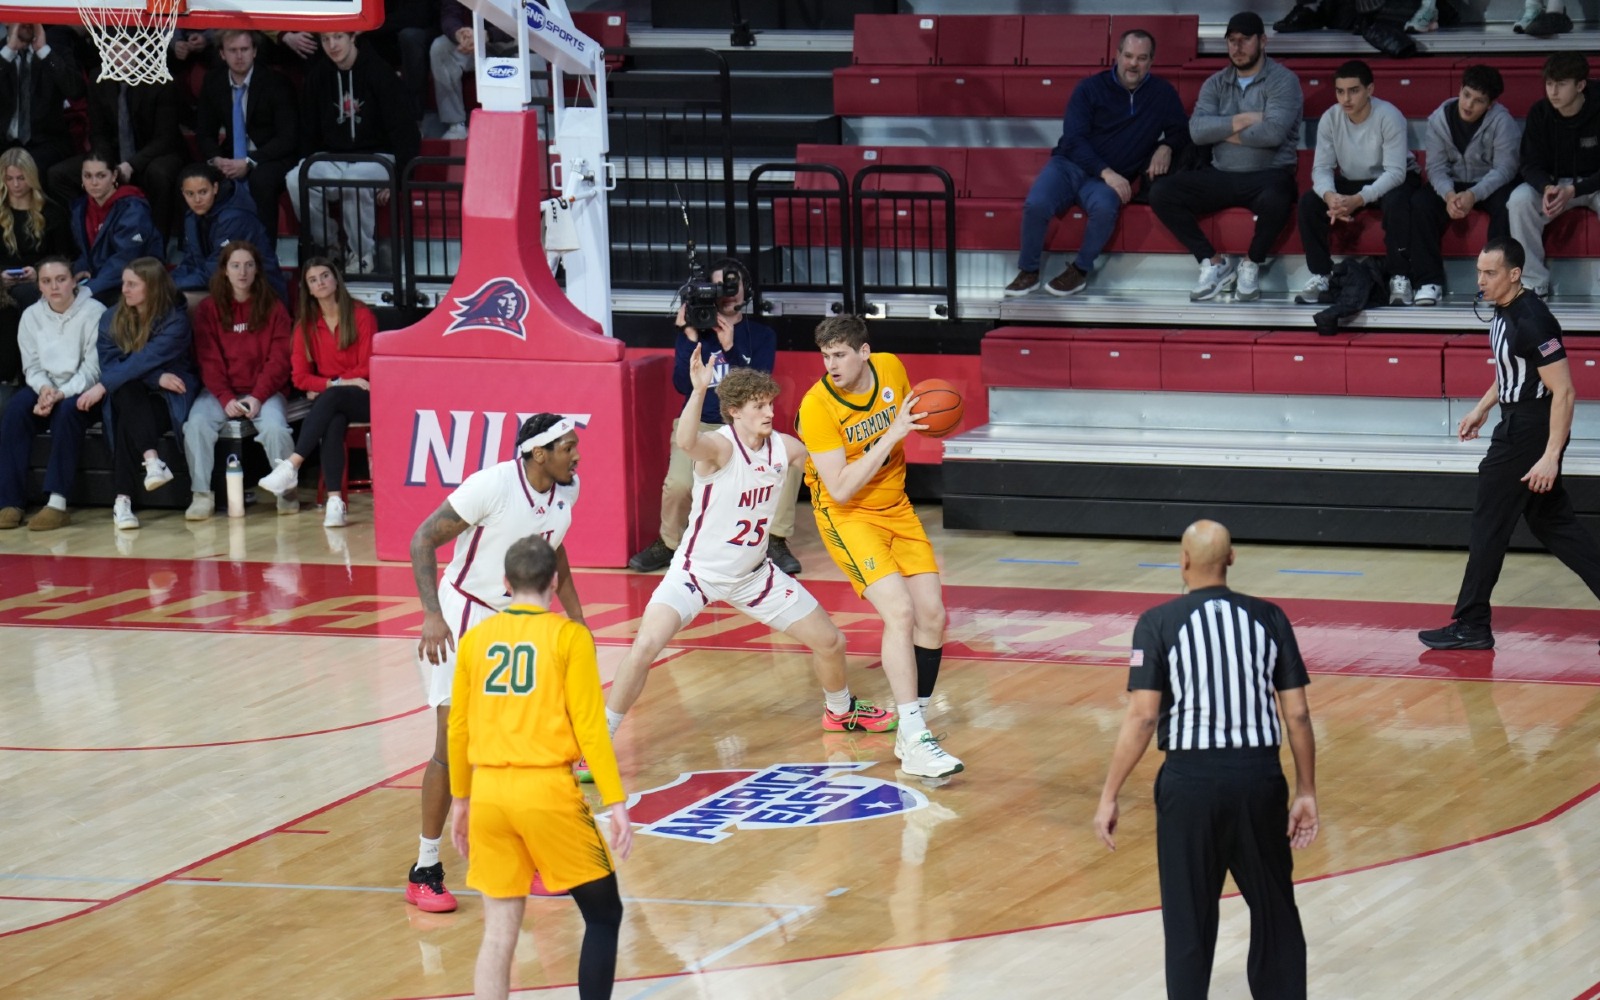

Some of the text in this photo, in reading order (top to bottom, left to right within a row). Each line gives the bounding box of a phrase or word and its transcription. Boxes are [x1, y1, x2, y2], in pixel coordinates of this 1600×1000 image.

[545, 20, 585, 52] SPORTS
[845, 405, 897, 444] VERMONT
[738, 484, 774, 511] NJIT
[726, 517, 768, 547] 25
[483, 641, 537, 696] 20
[650, 763, 860, 841] AMERICA
[740, 780, 867, 824] EAST
